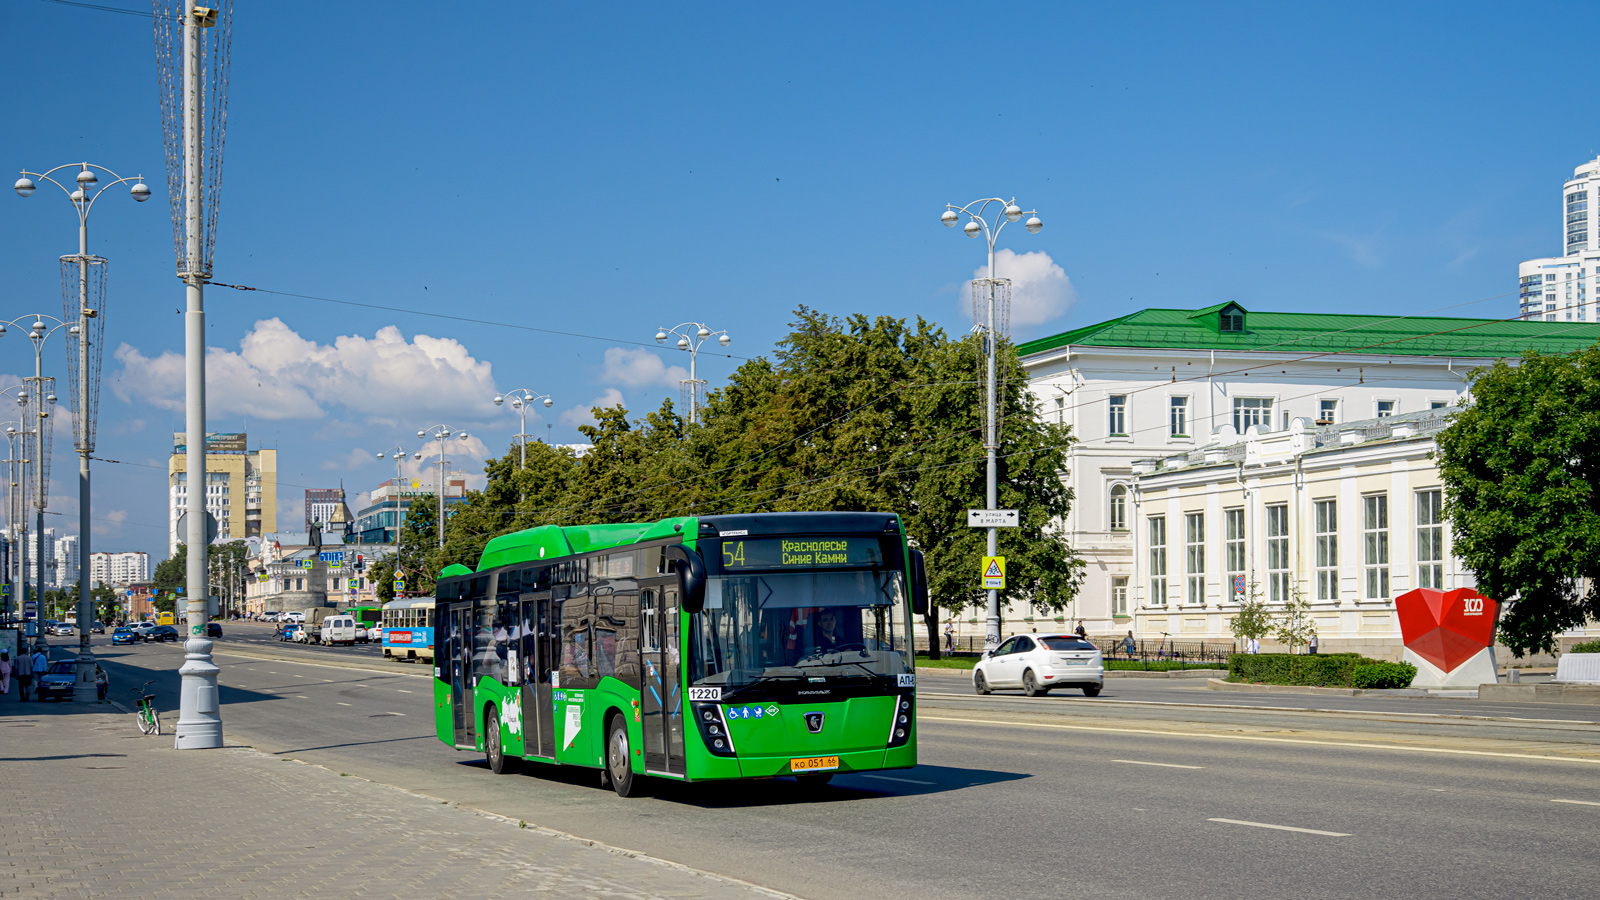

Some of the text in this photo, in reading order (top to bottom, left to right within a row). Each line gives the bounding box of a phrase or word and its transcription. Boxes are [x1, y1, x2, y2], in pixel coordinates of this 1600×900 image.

[781, 540, 847, 552] Краснолесье
[722, 541, 745, 567] 54
[782, 552, 847, 565] Синие Камни
[690, 688, 719, 699] 1220
[808, 758, 824, 767] 051
